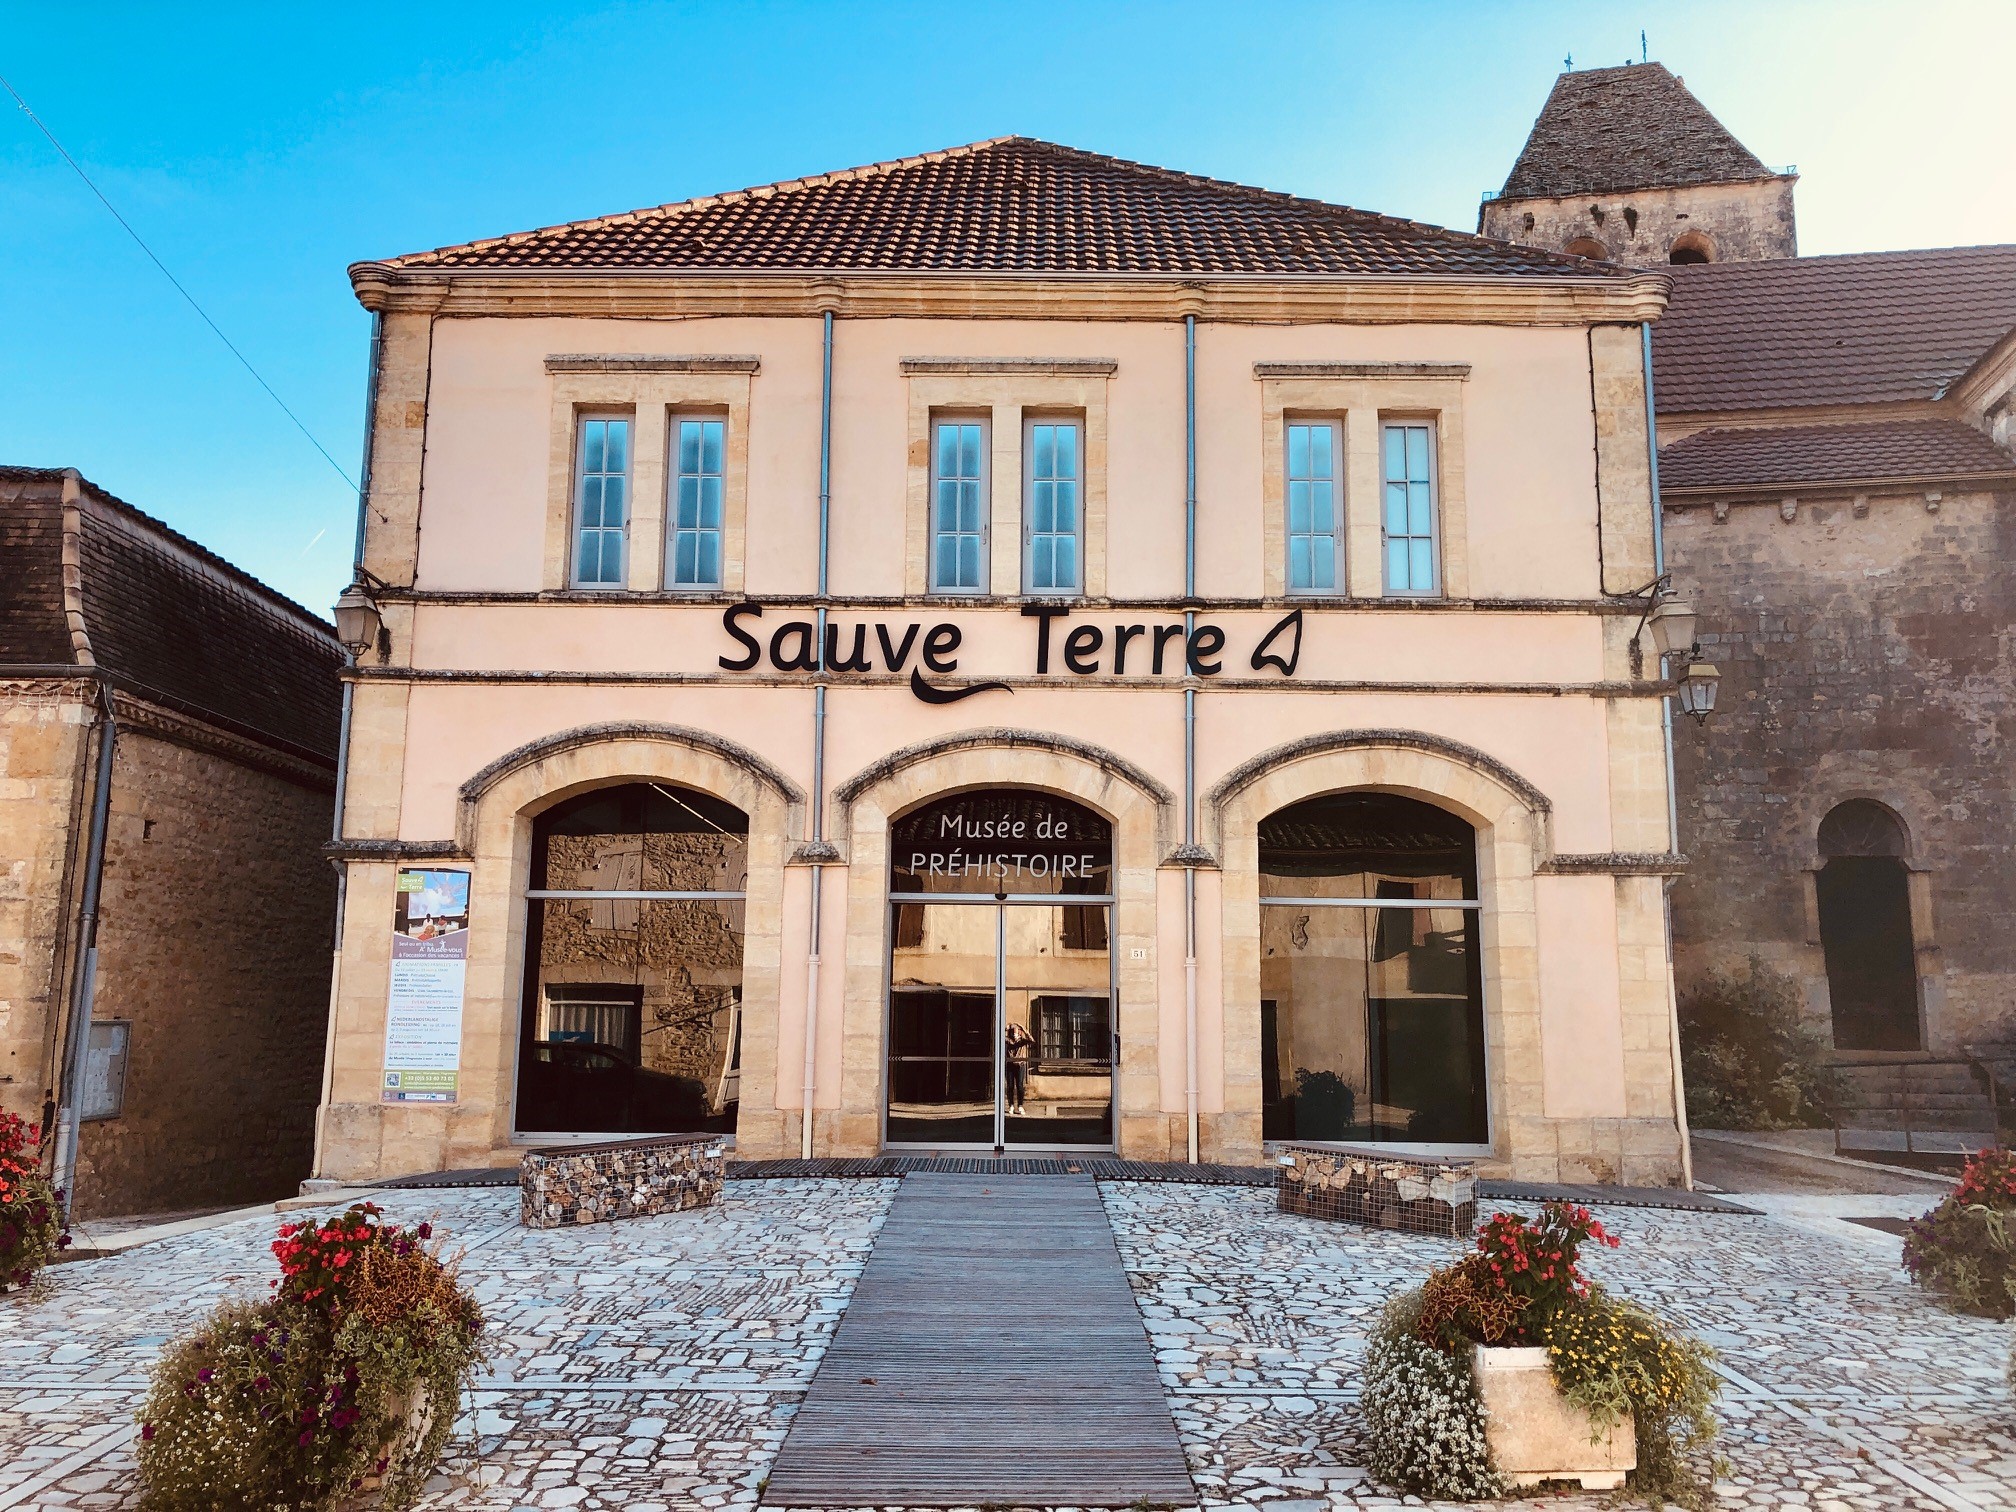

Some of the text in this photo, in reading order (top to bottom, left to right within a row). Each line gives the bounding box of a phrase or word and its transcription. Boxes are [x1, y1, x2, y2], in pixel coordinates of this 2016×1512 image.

[719, 603, 1226, 675] Sauve Terre
[940, 813, 1068, 839] Musée de
[910, 848, 1095, 878] PRÉHISTOIRE
[1133, 950, 1143, 958] 51
